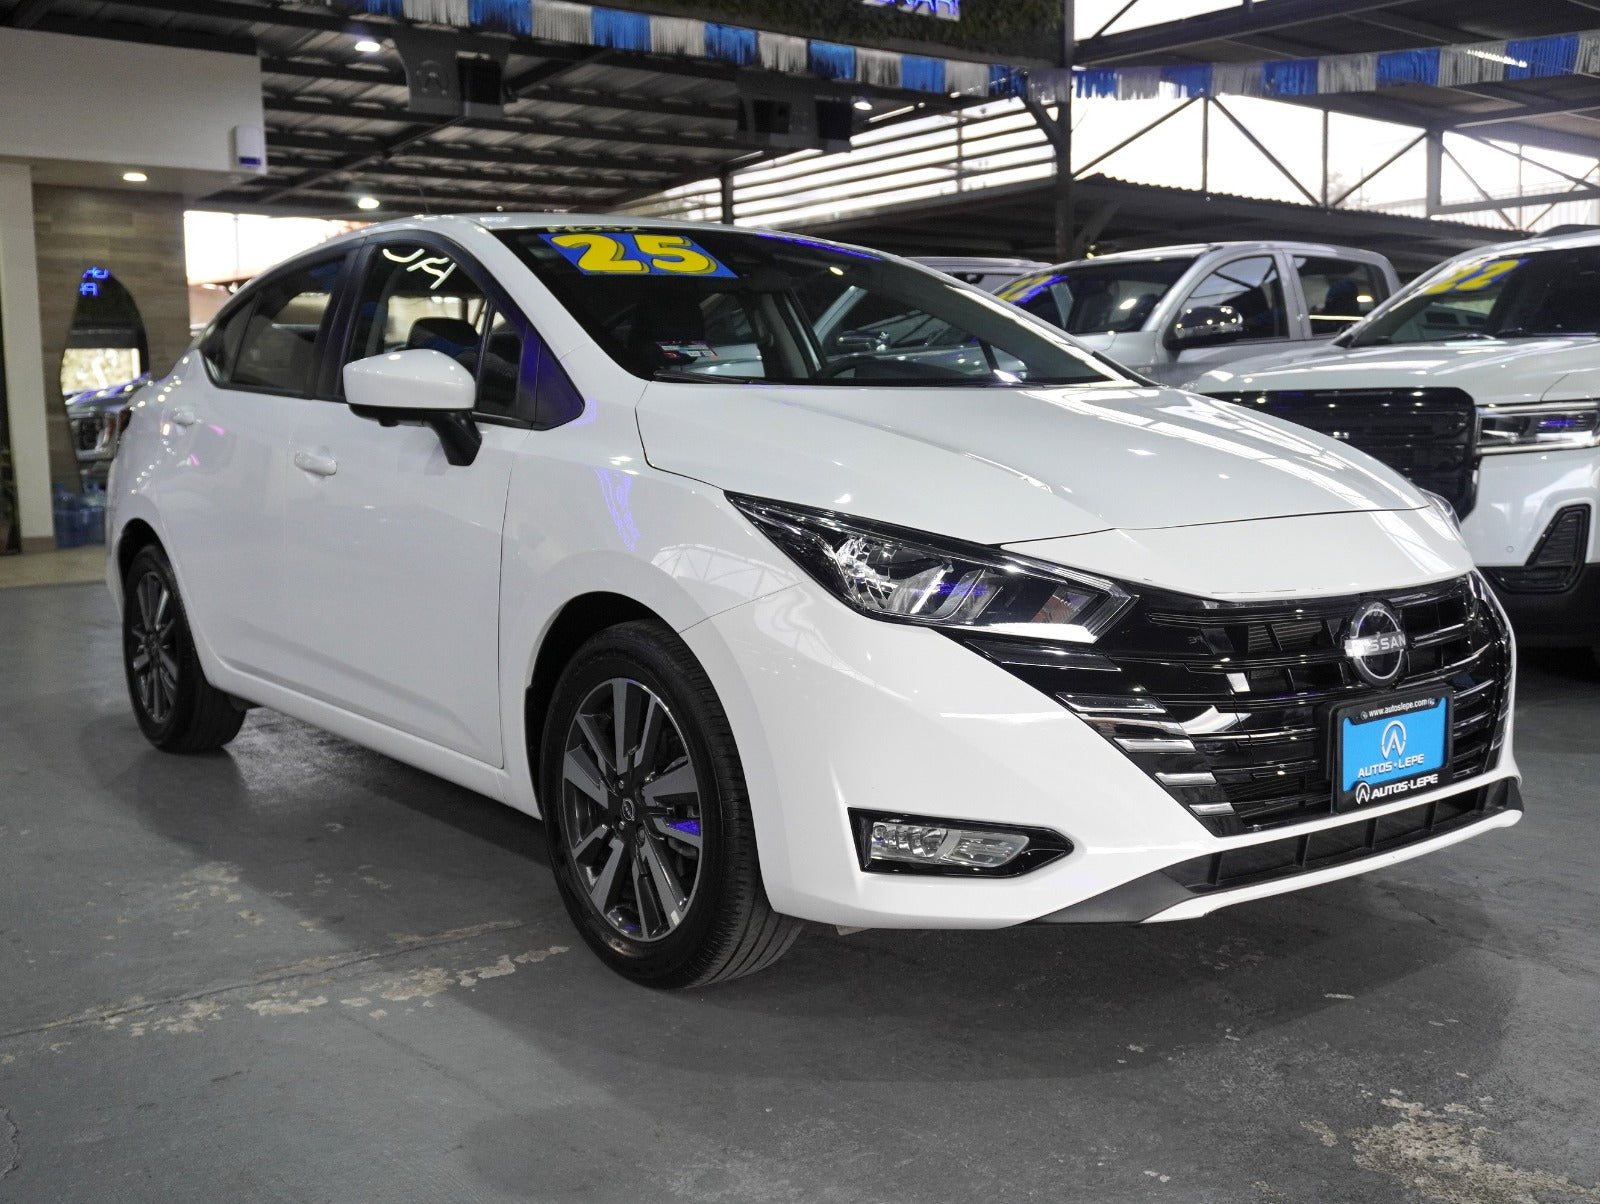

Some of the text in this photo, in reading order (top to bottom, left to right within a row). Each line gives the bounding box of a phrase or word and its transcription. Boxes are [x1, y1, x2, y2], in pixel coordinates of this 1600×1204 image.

[551, 233, 717, 274] 25
[1352, 633, 1406, 656] SSAN
[1368, 698, 1428, 718] www.autoslepe.com
